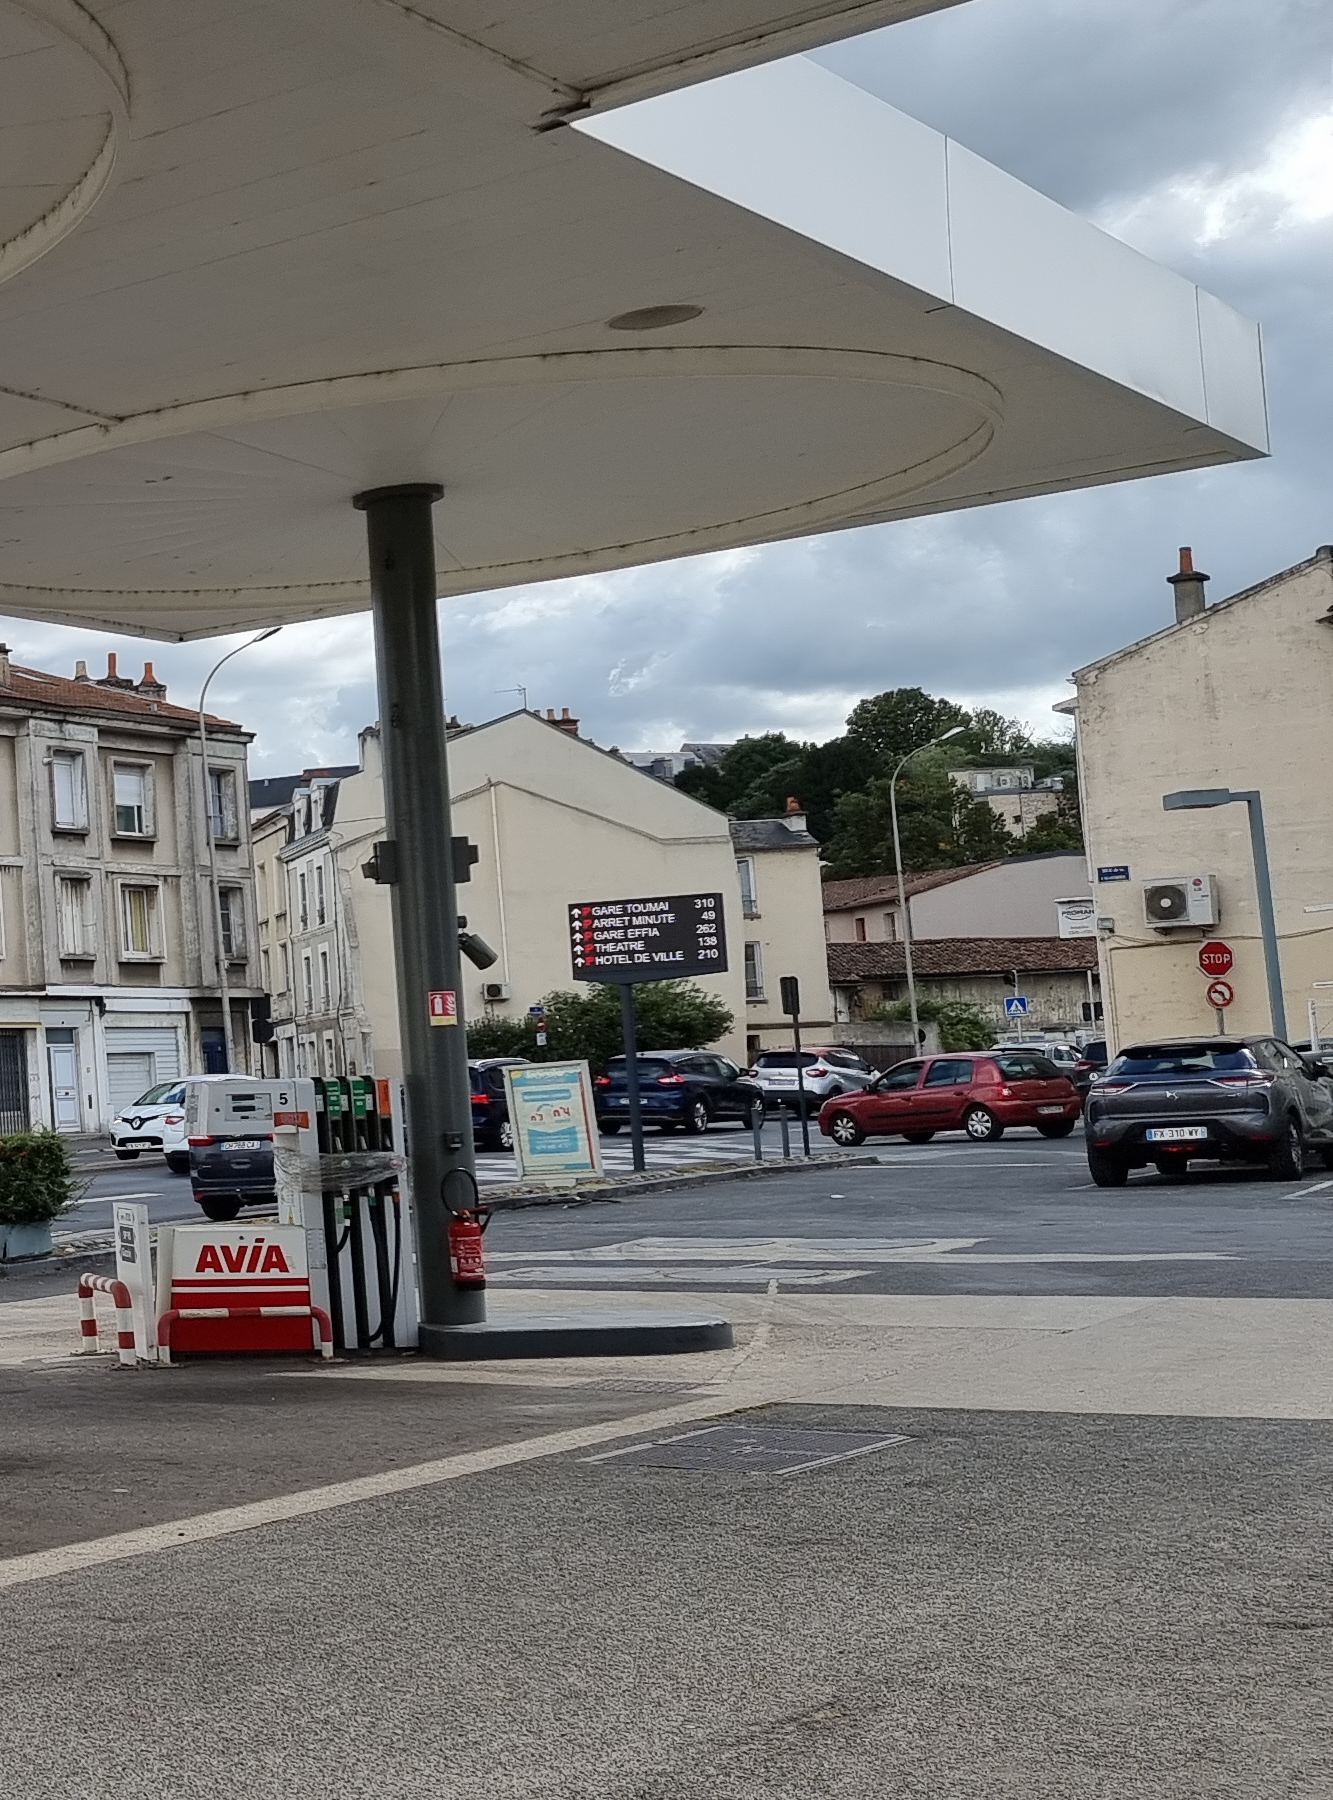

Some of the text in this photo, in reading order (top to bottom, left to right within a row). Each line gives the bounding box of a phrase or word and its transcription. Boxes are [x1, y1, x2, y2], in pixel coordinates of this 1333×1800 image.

[591, 904, 624, 916] GARE
[625, 901, 670, 914] TOUMAI
[693, 898, 715, 909] 310
[592, 916, 630, 929] ARRET
[632, 913, 677, 926] MINUTE
[701, 911, 716, 921] 49
[593, 929, 626, 941] GARE
[627, 927, 660, 938] EFFIA
[696, 923, 717, 934] 262
[594, 940, 645, 953] THEATRE
[697, 936, 718, 946] 138
[595, 953, 633, 966] HOTEL
[634, 952, 651, 963] DE
[652, 950, 685, 962] VILLE
[697, 949, 719, 960] 210
[1202, 953, 1231, 965] STOP
[279, 1092, 289, 1106] 5
[195, 1237, 290, 1274] AVIA
